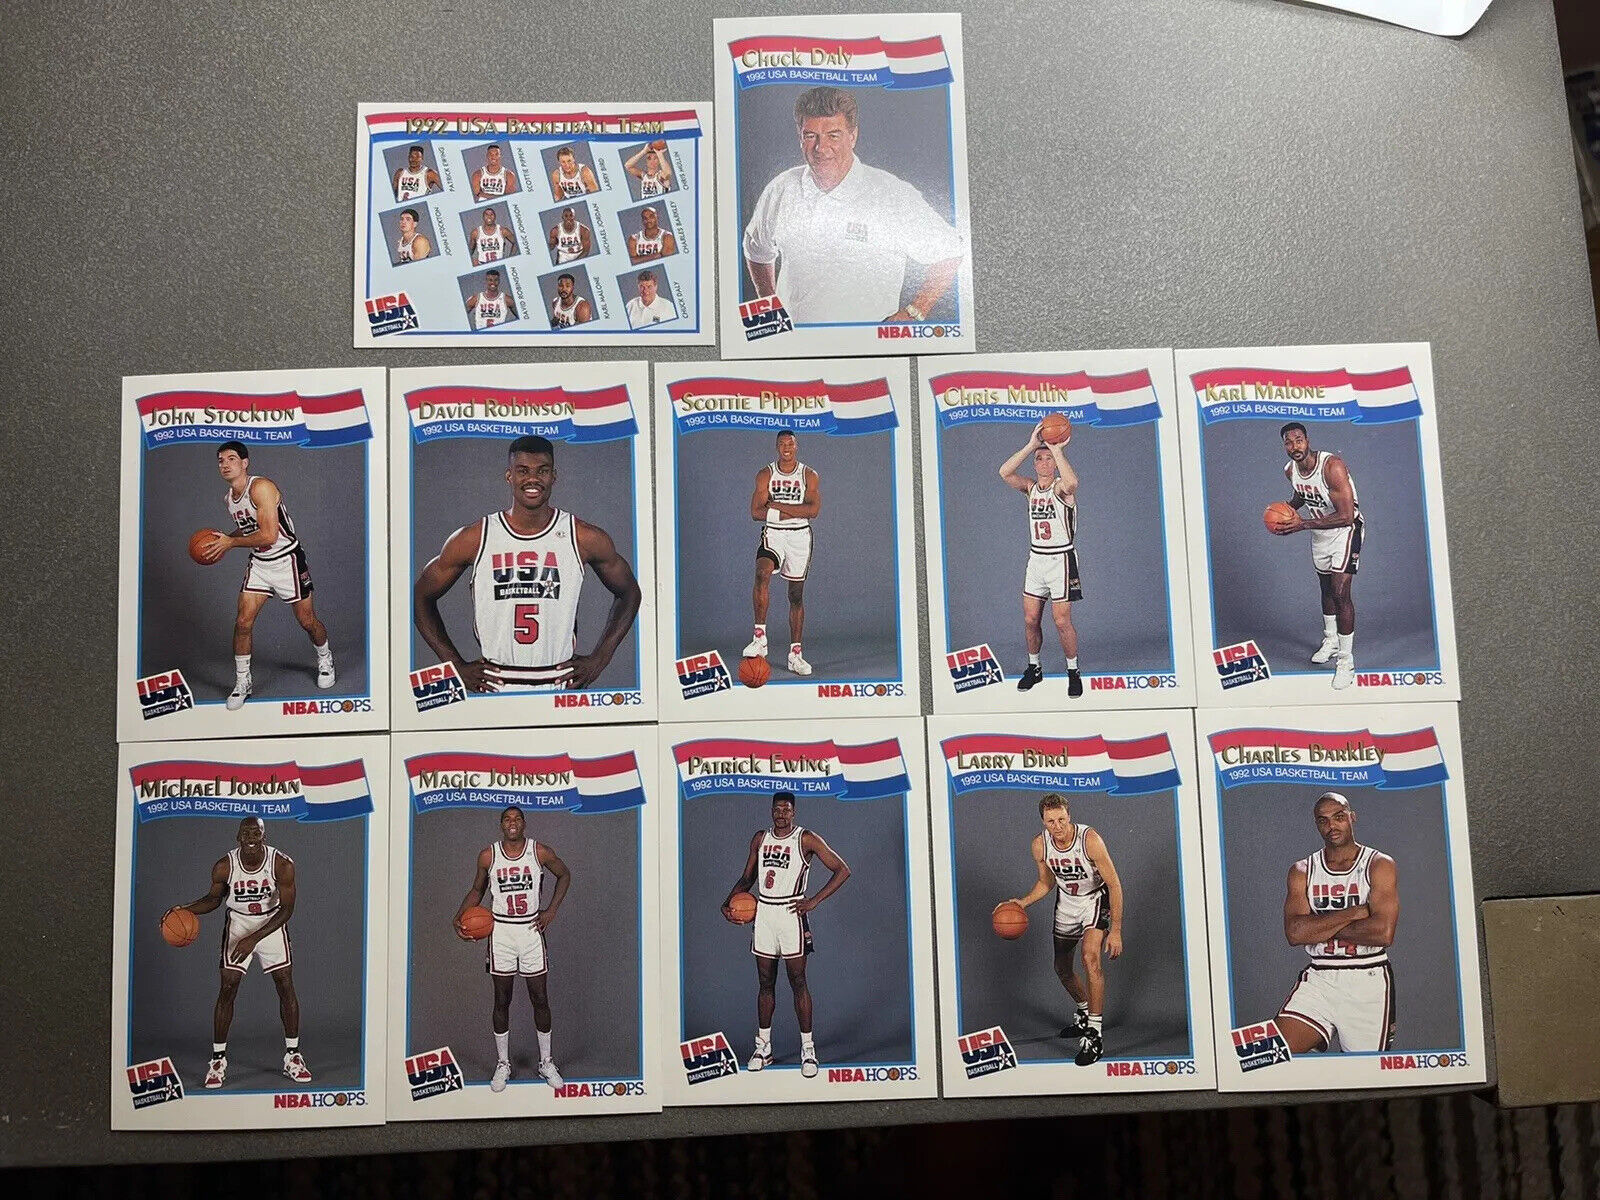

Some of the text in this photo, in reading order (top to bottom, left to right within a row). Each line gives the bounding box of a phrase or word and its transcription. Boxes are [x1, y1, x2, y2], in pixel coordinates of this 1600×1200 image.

[742, 46, 853, 68] Chuck Daly
[746, 70, 877, 82] 1992 USA BASKETBALL TEAM
[406, 117, 448, 135] 1992
[456, 117, 499, 134] USA
[517, 147, 534, 193] SCOTTIE PIPPEN
[679, 173, 689, 191] CHRIS
[435, 207, 452, 257] JOHN STOCKTON
[513, 204, 531, 255] MAGIC JOHNSON
[592, 203, 611, 255] MICHAEL JORDAN
[670, 201, 689, 254] CHARLES BARKLEY
[480, 239, 500, 247] USA
[638, 244, 658, 255] USA
[510, 267, 530, 319] DAVID ROBINSON
[673, 281, 689, 319] CHUCK DALY
[366, 293, 416, 324] USA
[480, 304, 500, 313] USA
[600, 301, 610, 319] KARL
[739, 297, 791, 326] USA
[372, 322, 402, 335] BASKETBALL
[746, 326, 776, 339] BASKETBALL
[944, 382, 1068, 406] Chris Mullin
[1206, 380, 1325, 401] Karl Malone
[419, 397, 575, 420] David Robinson
[682, 391, 826, 413] Scottie Pippen
[1210, 405, 1344, 416] 1992 USA BASKETBALL TEAM
[150, 403, 295, 426] John Stockton
[686, 415, 820, 427] 1992 USA BASKETBALL TEAM
[949, 410, 968, 420] 1992
[971, 408, 990, 417] USA
[154, 429, 292, 441] 1992 USA BASKETBALL TEAM
[423, 423, 559, 435] 1992 USA BASKETBALL TEAM
[772, 480, 801, 494] USA
[1296, 484, 1322, 500] USA
[1031, 498, 1054, 512] USA
[1035, 521, 1051, 540] 13
[492, 552, 561, 583] USA
[500, 587, 540, 596] BASKETBALL
[514, 604, 539, 644] 5
[947, 646, 998, 679] USA
[1213, 643, 1264, 676] USA
[676, 653, 727, 686] USA
[137, 672, 188, 705] USA
[410, 665, 460, 698] USA
[955, 677, 984, 691] BASKETBALL
[1222, 674, 1251, 688] BASKETBALL
[683, 684, 713, 697] BASKETBALL
[144, 705, 175, 716] BASKETBALL
[418, 696, 448, 709] BASKETBALL
[958, 747, 1068, 770] Larry Bird
[1222, 742, 1386, 764] Charles Barkley
[688, 754, 830, 776] Patrick Ewing
[1229, 768, 1368, 780] 1992 USA BASKETBALL TEAM
[140, 775, 300, 798] Michael Jordan
[419, 766, 570, 789] Magic Johnson
[691, 778, 830, 791] 1992 USA BASKETBALL TEAM
[961, 774, 1100, 786] 1992 USA BASKETBALL TEAM
[147, 801, 290, 813] 1992 USA BASKETBALL TEAM
[423, 792, 563, 805] 1992 USA BASKETBALL TEAM
[763, 845, 790, 861] USA
[1049, 858, 1085, 873] USA
[497, 866, 532, 884] USA
[765, 870, 776, 889] 6
[234, 879, 272, 896] USA
[1066, 884, 1079, 896] 7
[1313, 884, 1360, 908] USA
[506, 894, 528, 914] 15
[958, 1030, 1012, 1064] USA
[1231, 1023, 1284, 1058] USA
[680, 1035, 732, 1070] USA
[405, 1050, 458, 1085] USA
[967, 1063, 998, 1076] BASKETBALL
[1241, 1056, 1271, 1070] BASKETBALL
[127, 1059, 180, 1094] USA
[689, 1069, 719, 1082] BASKETBALL
[413, 1084, 443, 1098] BASKETBALL
[134, 1094, 164, 1107] BASKETBALL
